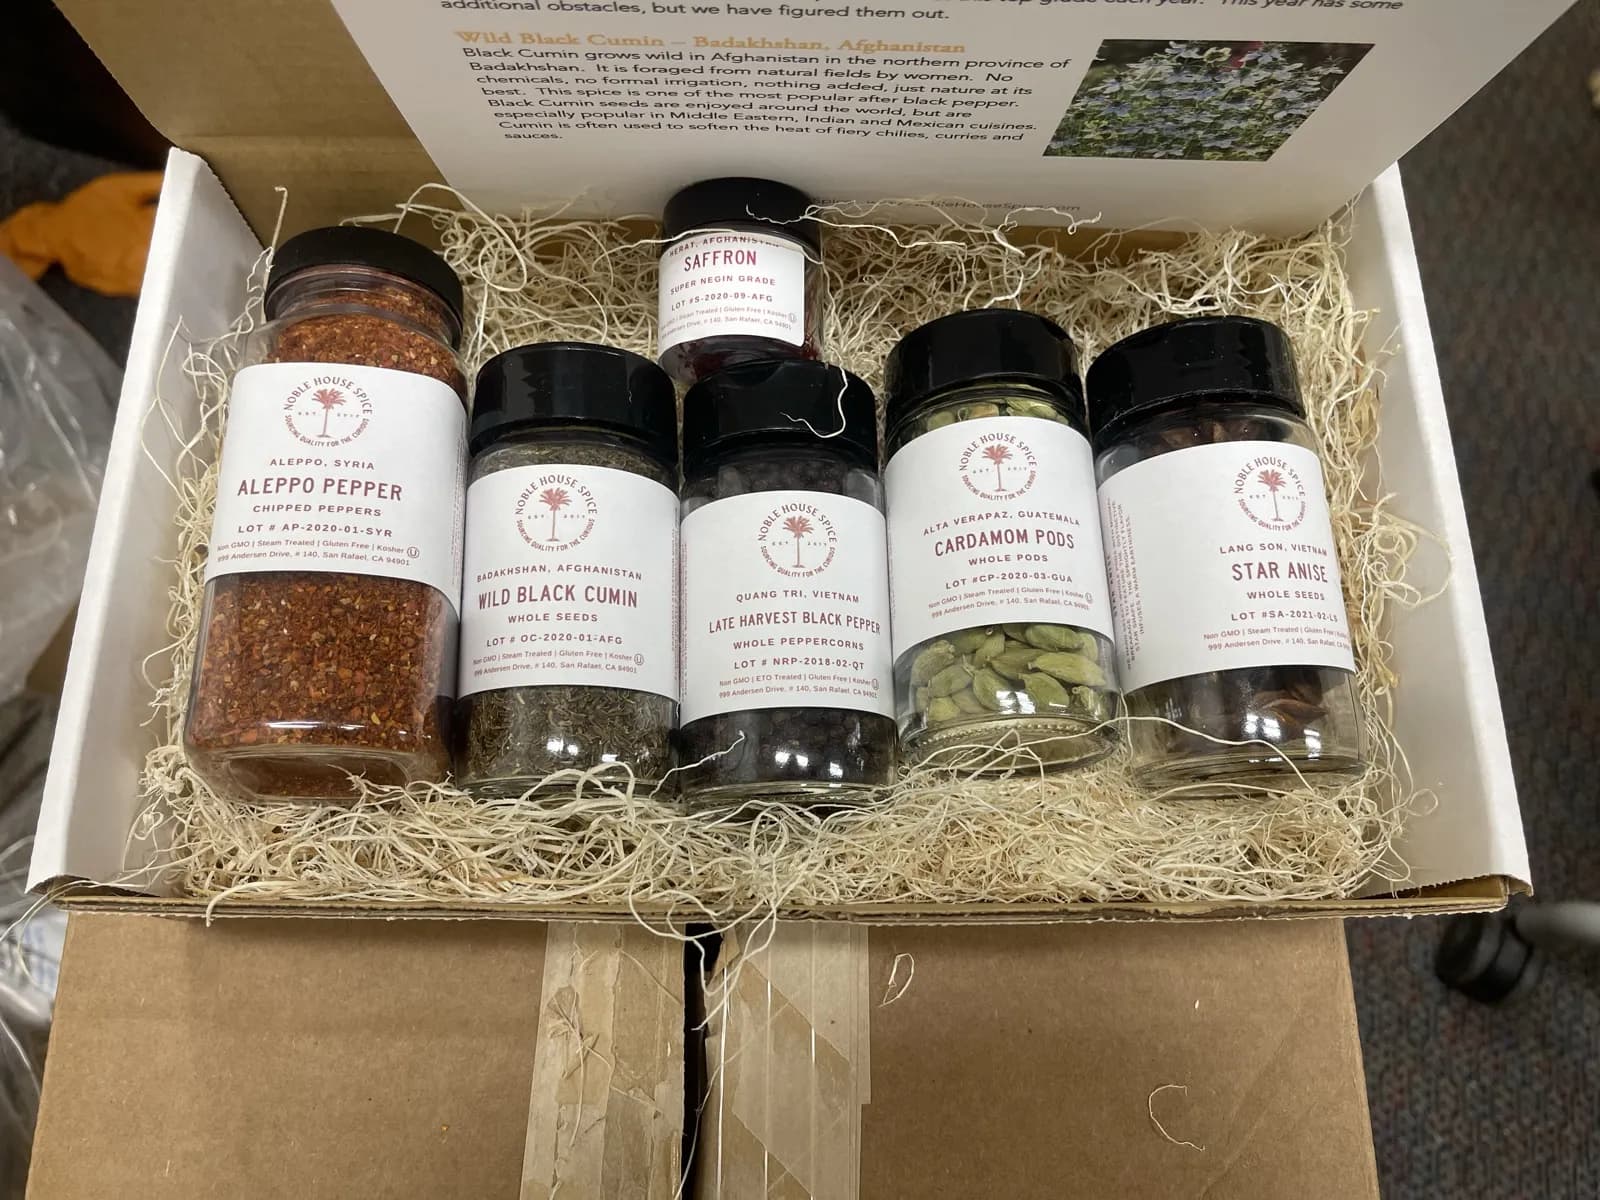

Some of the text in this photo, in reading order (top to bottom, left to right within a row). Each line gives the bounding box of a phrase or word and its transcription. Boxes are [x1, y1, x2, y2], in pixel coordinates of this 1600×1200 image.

[440, 0, 949, 19] additional obstacles, but we have figured them out.
[1311, 0, 1404, 10] has some
[454, 31, 965, 53] Wild Black Cumin Badakhshan, Afghanistan
[462, 47, 513, 58] Black
[517, 48, 579, 58] Cumin
[584, 52, 640, 61] grows
[644, 51, 683, 60] wild
[710, 52, 819, 64] Afghanistan
[825, 55, 840, 64] in
[847, 55, 876, 65] the
[883, 56, 960, 67] northern
[964, 58, 1044, 70] province
[1049, 58, 1072, 68] of
[469, 61, 1013, 82] Badakhshan. It is foraged from natural fields by women. No
[476, 74, 568, 85] chemicals,
[602, 76, 658, 85] formal
[664, 77, 747, 88] irrigation,
[754, 79, 820, 91] nothing
[826, 81, 887, 92] added,
[893, 83, 925, 93] just
[930, 86, 986, 94] nature
[990, 87, 1008, 95] at
[1012, 86, 1032, 95] its
[481, 87, 526, 96] best.
[535, 87, 572, 95] This
[576, 87, 622, 98] spice
[627, 88, 640, 96] is
[683, 89, 701, 97] of
[706, 89, 734, 98] the
[739, 92, 782, 100] most
[786, 92, 854, 102] popular
[858, 94, 898, 103] after
[903, 95, 947, 106] black
[951, 100, 1018, 109] pepper.
[487, 98, 534, 107] Black
[538, 98, 594, 107] Cumin
[599, 99, 648, 108] seeds
[685, 101, 753, 111] enjoyed
[758, 103, 818, 112] around
[824, 104, 850, 113] the
[855, 107, 906, 117] world,
[912, 108, 941, 117] but
[494, 109, 1036, 130] especially popular in Middle Eastern, Indian and Mexican cuisines.
[684, 249, 756, 272] SAFFRON
[670, 274, 775, 296] SUPER NEGIN GRADE
[671, 299, 685, 312] LOT
[283, 376, 373, 415] NOBLE HOUSE SPICE
[959, 432, 1038, 472] NOBLE HOUSE SPICE
[269, 457, 374, 470] ALEPPO, SYRIA
[1234, 456, 1306, 497] NOBLE HOUSE SPICE
[237, 476, 402, 501] ALEPPO PEPPER
[515, 474, 598, 515] NOBLE HOUSE SPICE
[252, 504, 381, 517] CHIPPED PEPPERS
[238, 524, 263, 533] LOT
[281, 522, 392, 538] AP-2020-01-SYR
[757, 503, 838, 543] NOBLE HOUSE SPICE
[923, 510, 1079, 536] ALTA VERAPAZ, GUATEMALA
[934, 528, 1074, 557] CARDAMOM PODS
[1219, 542, 1327, 557] LANG SON, VIETNAM
[968, 553, 1048, 566] WHOLE PODS
[476, 564, 642, 583] BADAKHSHAN, AFGHANISTAN
[1231, 561, 1328, 583] STAR ANISE
[945, 578, 966, 590] LOT
[478, 584, 637, 610] WILD BLACK CUMIN
[736, 589, 859, 603] QUANG TRI, VIETNAM
[1246, 590, 1325, 601] WHOLE SEEDS
[507, 612, 598, 624] WHOLE SEEDS
[709, 611, 880, 635] LATE HARVEST BLACK PEPPER
[1231, 611, 1255, 621] LOT
[486, 636, 505, 648] LOT
[520, 632, 622, 645] OC-2020-01-AFG
[732, 637, 864, 651] WHOLE PEPPERCORNS
[734, 659, 756, 670] LOT
[772, 656, 864, 671] NRP-2018-02-QT
